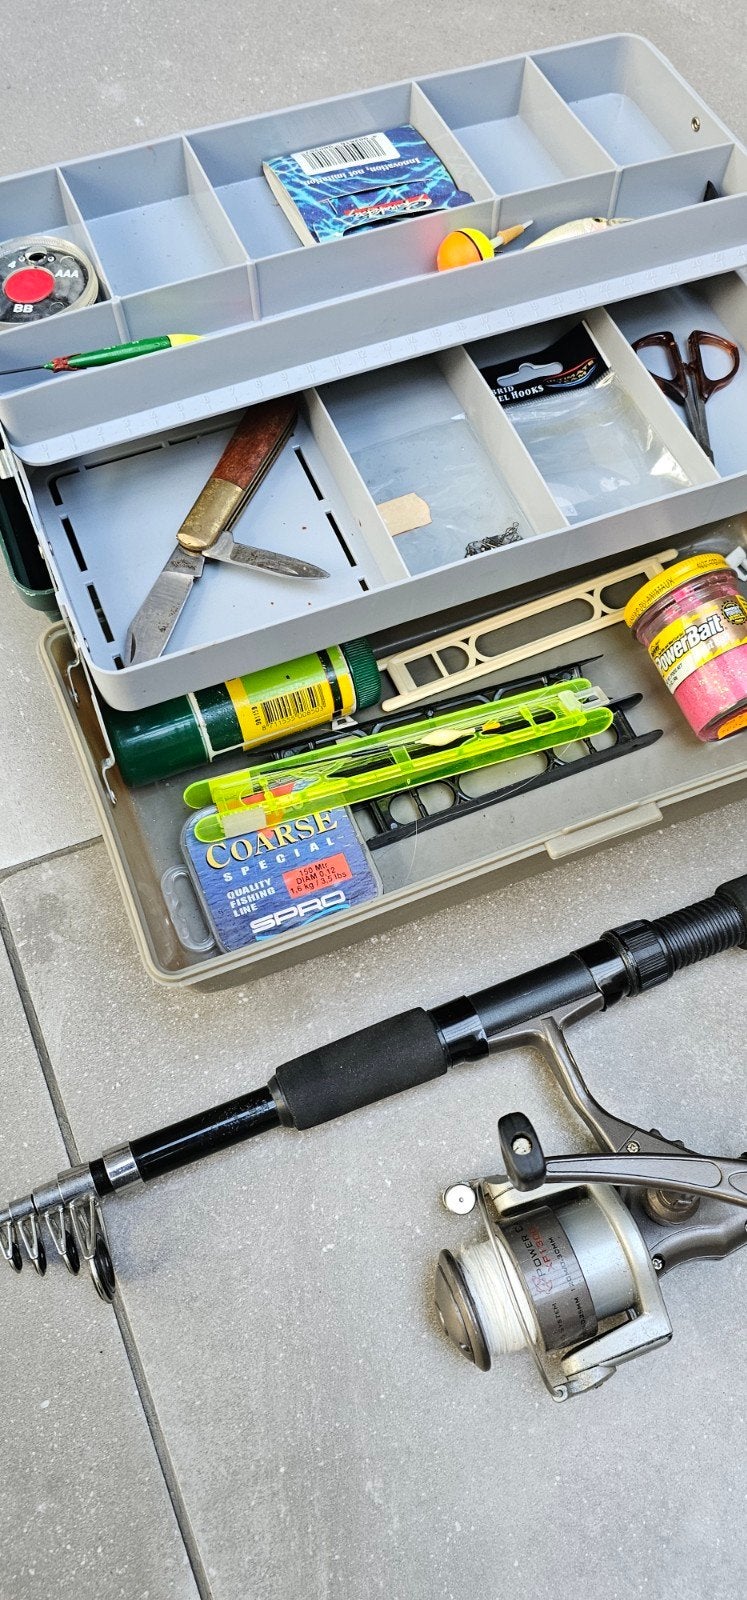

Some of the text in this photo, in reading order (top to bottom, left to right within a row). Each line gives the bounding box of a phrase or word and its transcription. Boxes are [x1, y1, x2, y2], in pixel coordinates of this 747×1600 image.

[366, 157, 421, 172] Innovation,
[349, 169, 365, 177] not
[7, 260, 16, 268] 4
[54, 269, 79, 278] AAA
[13, 303, 34, 313] BB
[511, 385, 544, 399] HOOKS
[654, 613, 724, 672] PowerBait
[206, 809, 338, 870] COARSE
[222, 837, 335, 882] SPECIAL
[299, 863, 327, 876] 150 Mtr
[296, 873, 317, 885] DIAM
[304, 882, 315, 890] kg
[334, 872, 347, 880] lbs
[226, 878, 272, 900] QUALITY
[229, 888, 276, 909] FISHING
[233, 903, 258, 918] LINE
[250, 890, 346, 934] SPRO
[521, 1234, 546, 1277] POWER
